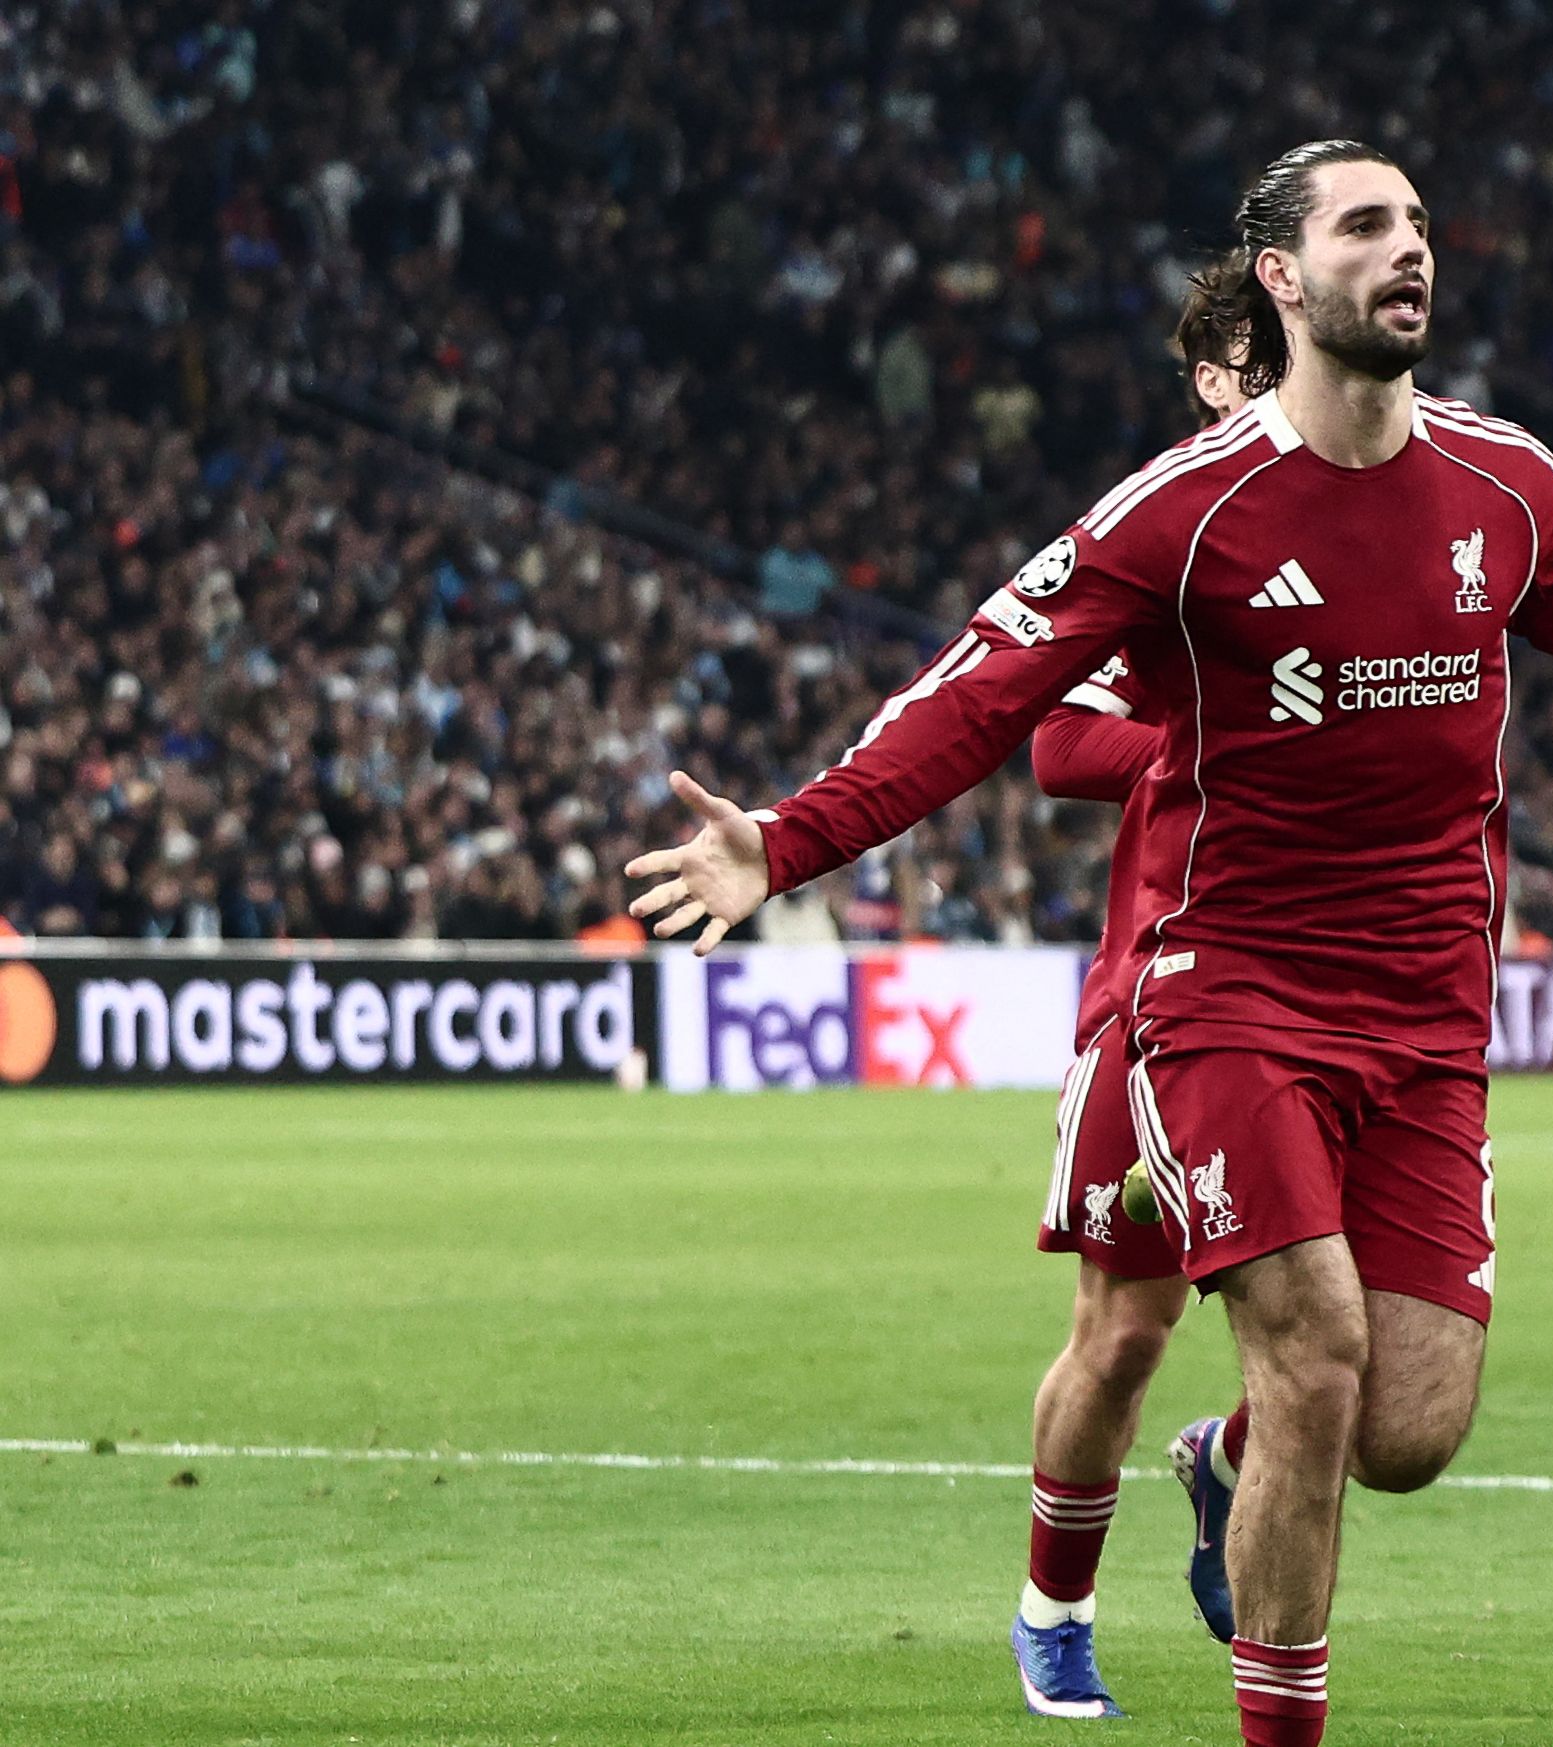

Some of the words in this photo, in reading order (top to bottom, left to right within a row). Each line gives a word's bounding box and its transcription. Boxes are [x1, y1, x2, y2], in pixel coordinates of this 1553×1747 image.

[1337, 674, 1481, 710] chartered
[1338, 648, 1481, 683] standard
[77, 960, 635, 1073] mastercard
[707, 961, 970, 1086] FedEx
